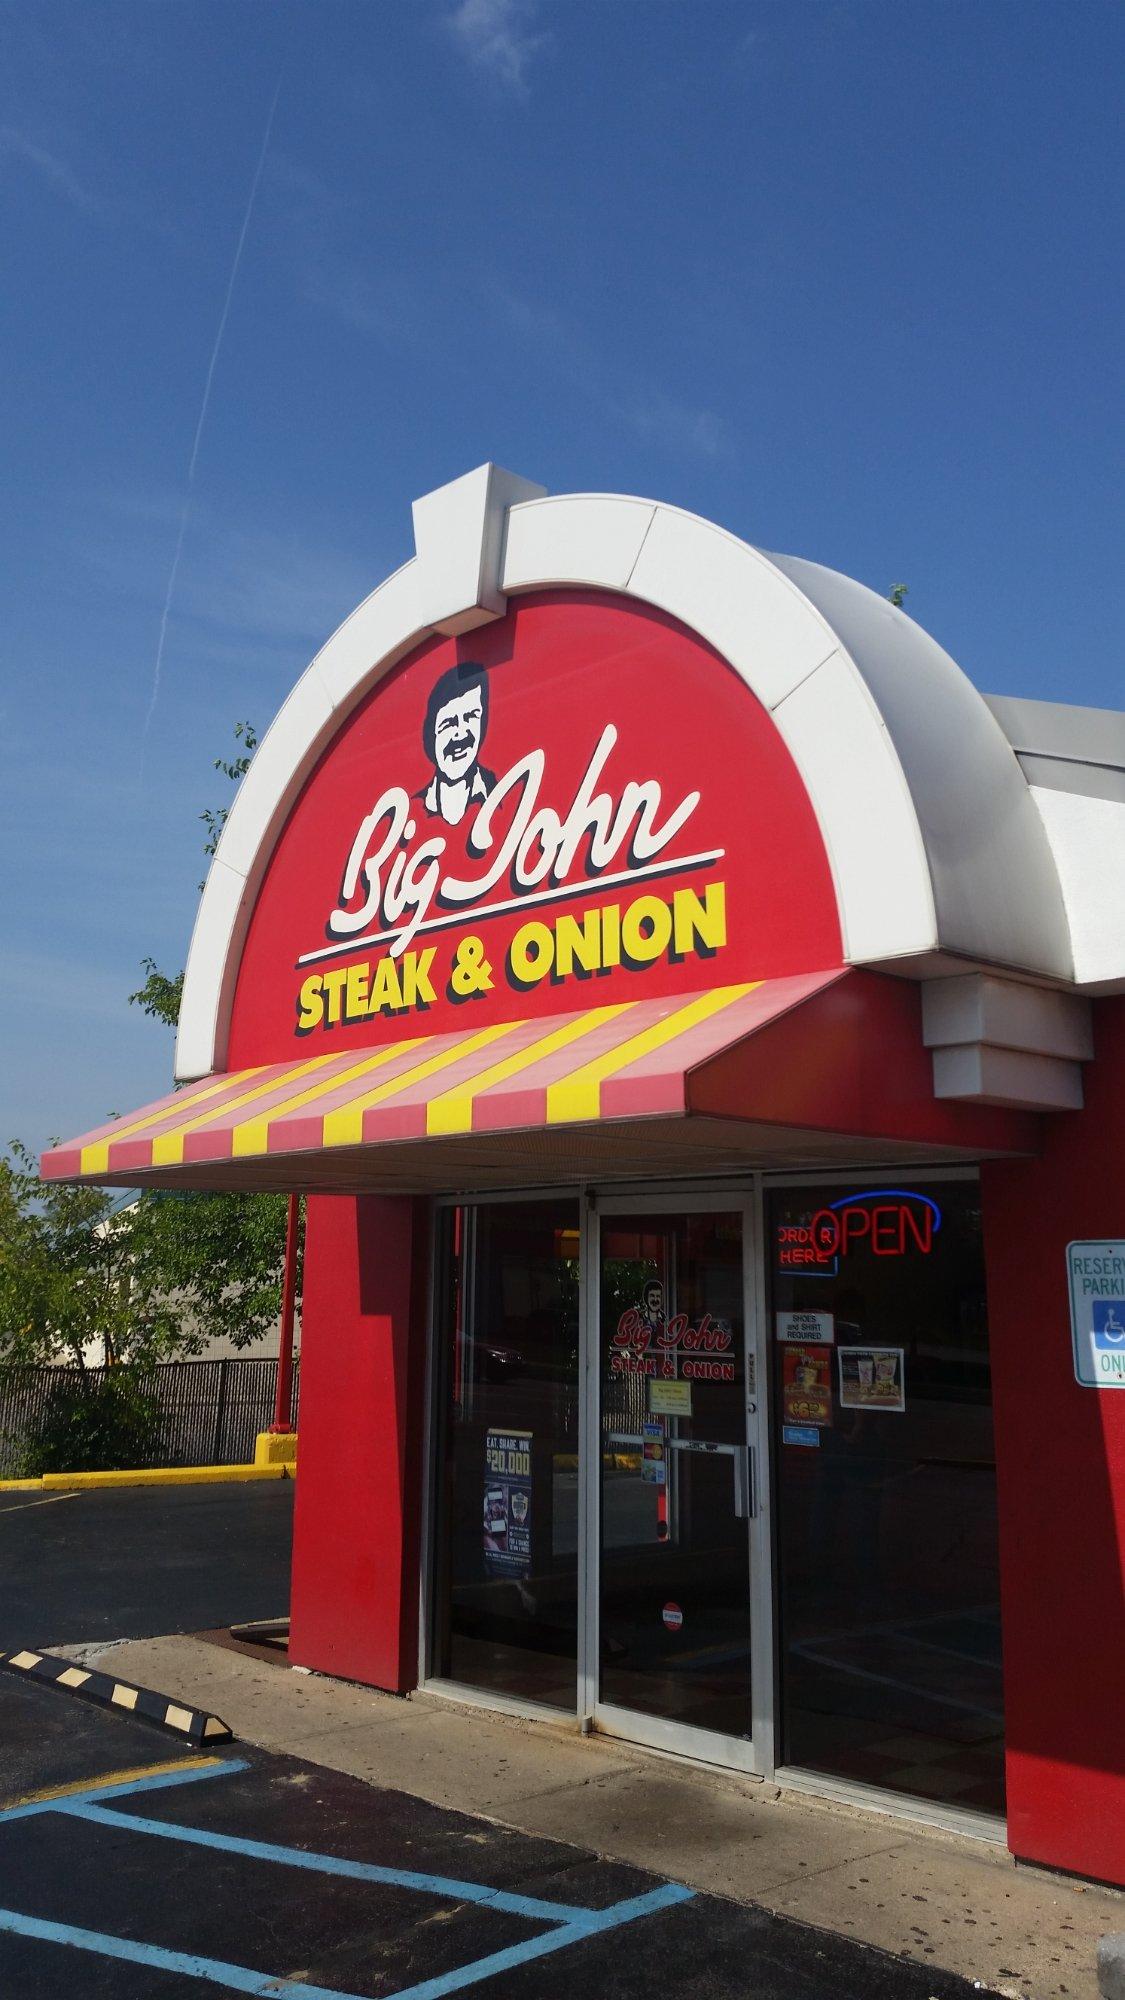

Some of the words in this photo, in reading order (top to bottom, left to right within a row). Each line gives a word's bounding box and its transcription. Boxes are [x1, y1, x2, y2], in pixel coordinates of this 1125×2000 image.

[330, 787, 446, 957] Big
[440, 724, 701, 900] John
[300, 947, 437, 1029] STEAK
[451, 936, 495, 996] &
[511, 882, 727, 983] ONION
[778, 1229, 832, 1244] ORDR
[812, 1206, 932, 1256] OPEN
[1073, 1258, 1125, 1275] RESER
[792, 1314, 816, 1322] SHOES
[801, 1323, 821, 1332] SHIRT
[613, 1308, 652, 1357] Big
[657, 1313, 732, 1351] John
[787, 1331, 822, 1340] REQUIRED
[611, 1356, 657, 1375] STEAK
[662, 1360, 675, 1377] &
[683, 1361, 734, 1380] ONION
[487, 1449, 530, 1476] $20,000
